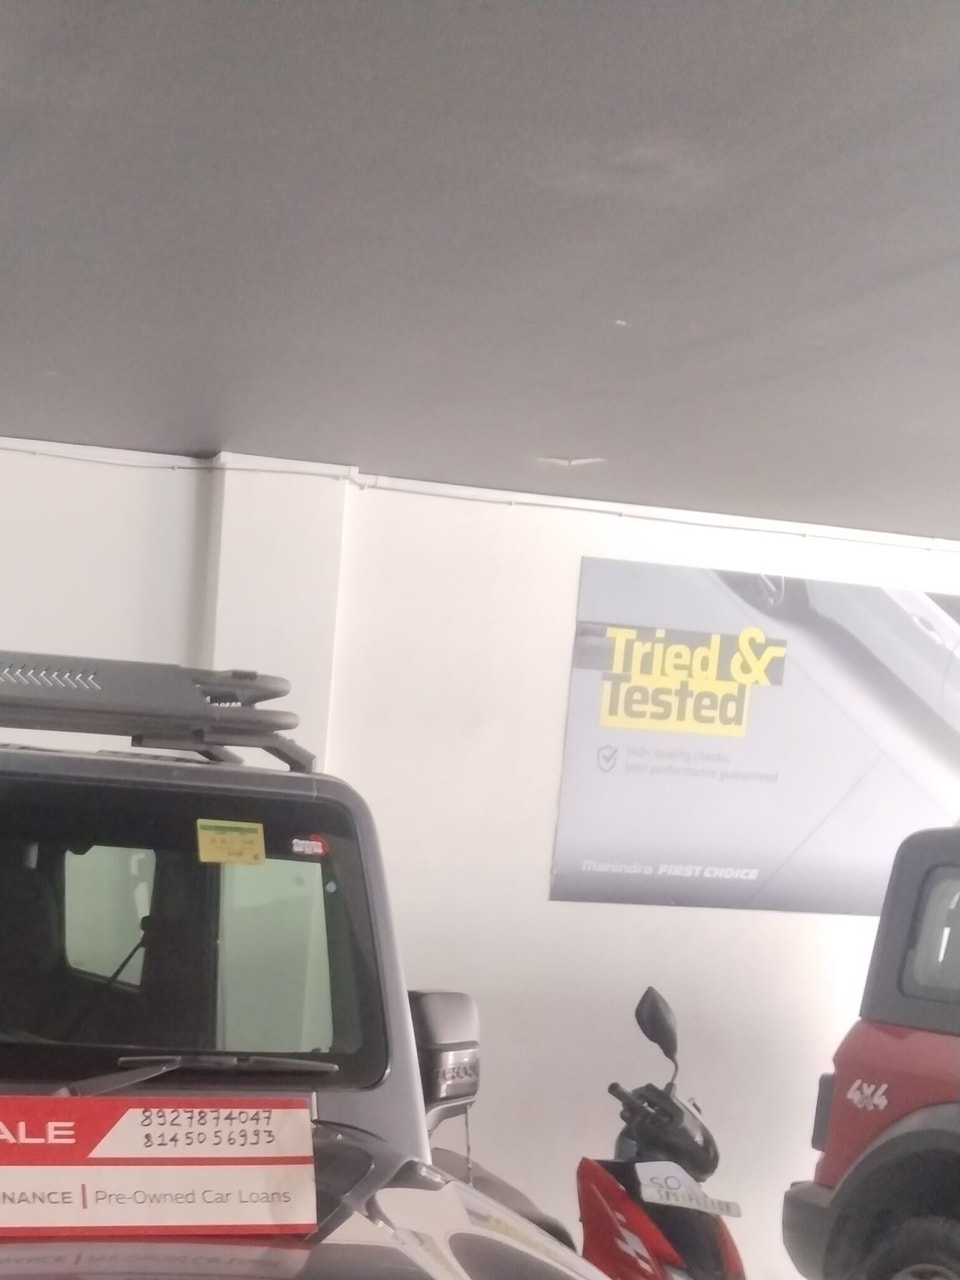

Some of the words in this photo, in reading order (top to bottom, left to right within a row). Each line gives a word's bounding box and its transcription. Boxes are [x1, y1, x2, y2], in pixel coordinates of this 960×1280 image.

[605, 627, 721, 681] Tried
[730, 626, 788, 686] &
[602, 672, 748, 726] Tested
[657, 863, 703, 878] FIRST
[703, 866, 759, 881] CHOICE
[140, 1108, 274, 1128] 8927874047
[95, 1188, 197, 1205] Pre-Owned
[201, 1189, 233, 1204] Car
[238, 1188, 292, 1204] Loans
